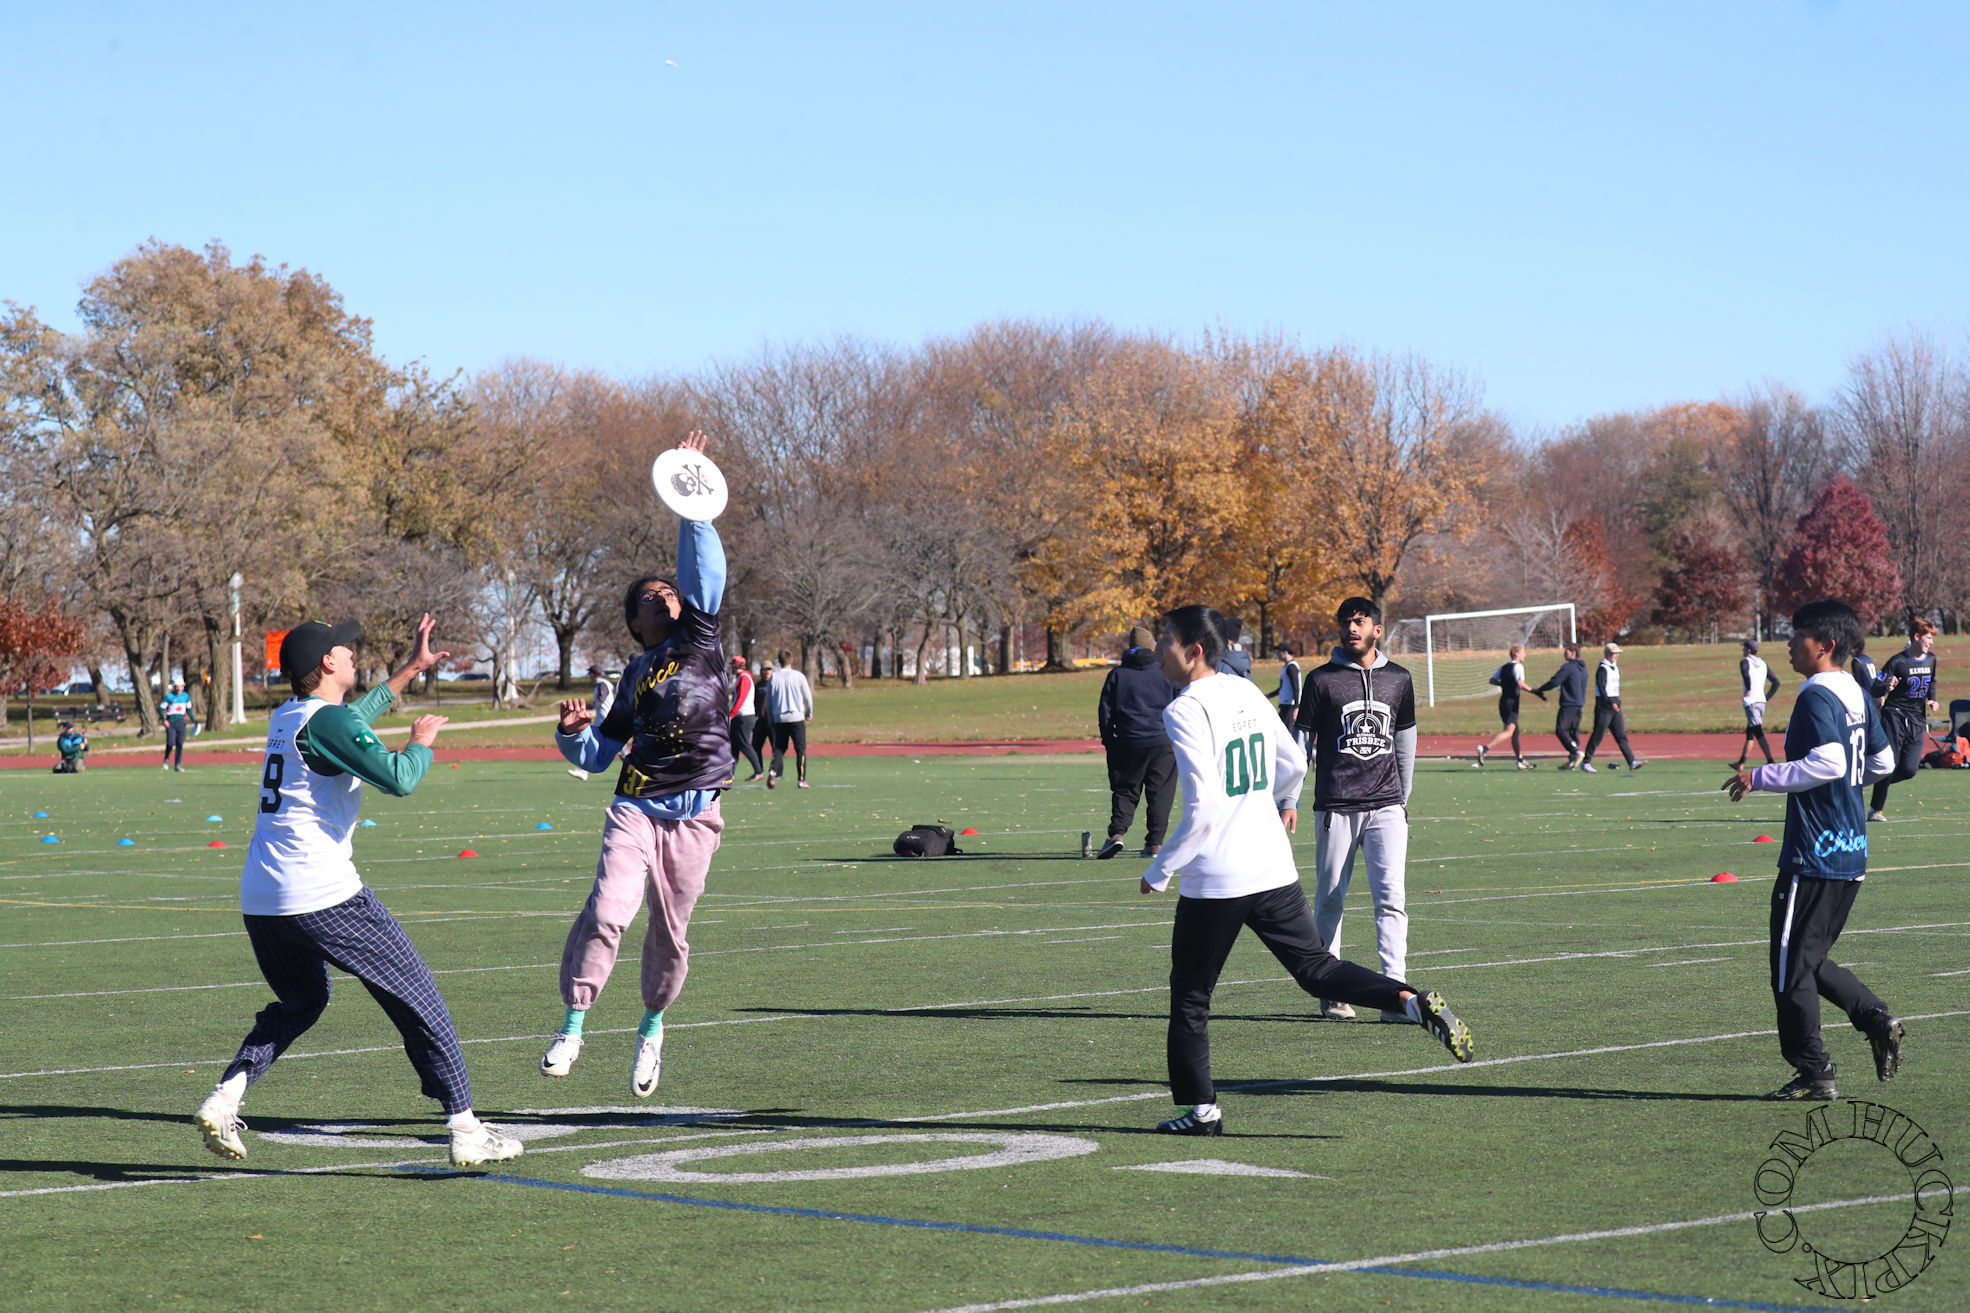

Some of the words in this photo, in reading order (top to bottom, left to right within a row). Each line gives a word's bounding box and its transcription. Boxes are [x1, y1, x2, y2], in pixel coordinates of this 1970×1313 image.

[1906, 675, 1932, 698] 25
[1225, 732, 1268, 798] 00
[1346, 736, 1386, 747] FRISBEE
[1849, 727, 1866, 787] 13
[258, 752, 285, 814] 9
